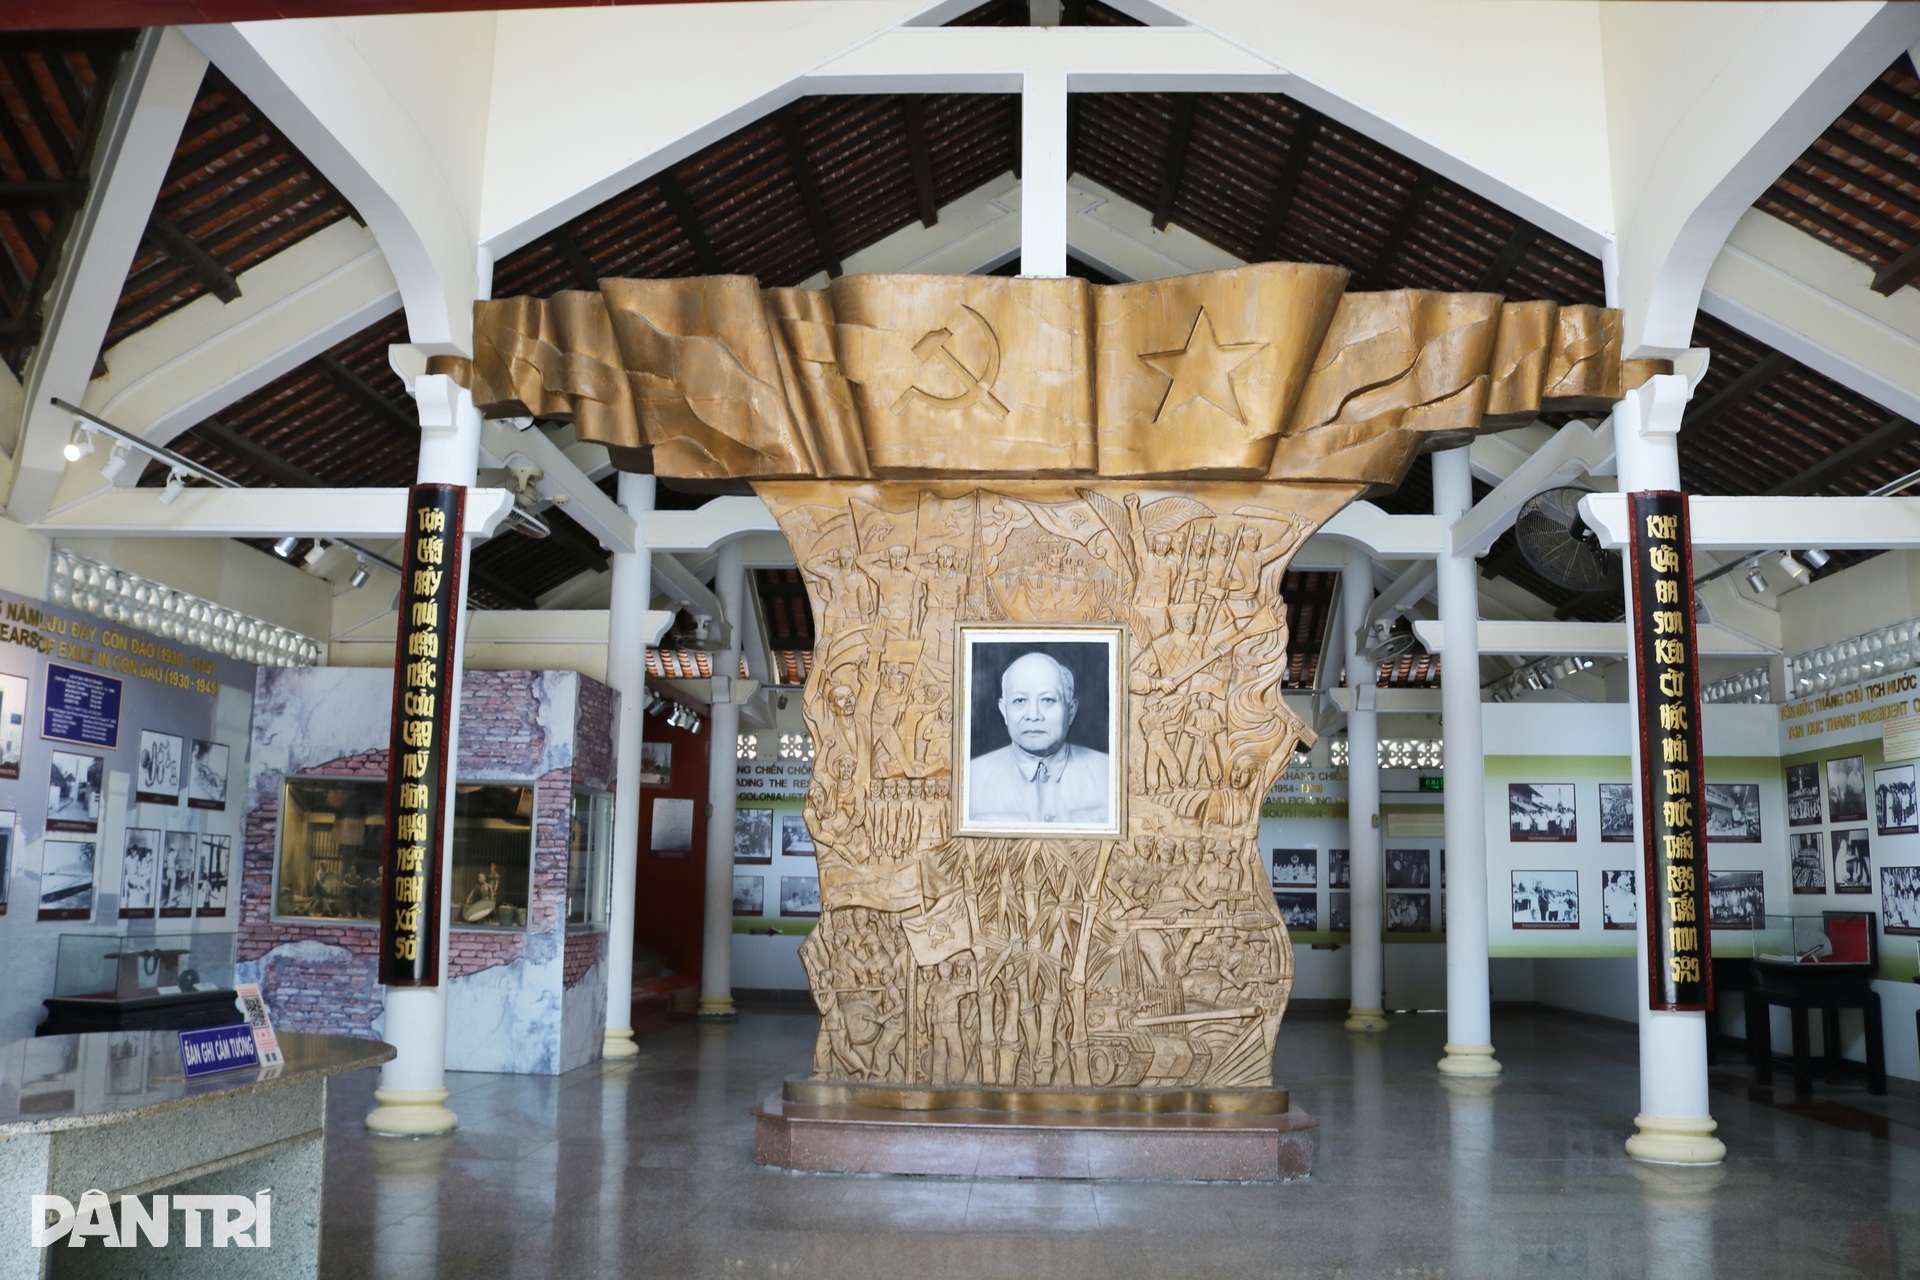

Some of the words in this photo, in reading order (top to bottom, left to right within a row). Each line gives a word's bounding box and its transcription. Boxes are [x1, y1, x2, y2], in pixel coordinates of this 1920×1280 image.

[0, 622, 39, 649] EARS
[769, 779, 787, 788] THE
[201, 1041, 216, 1063] GHI
[214, 1034, 231, 1061] CẢM
